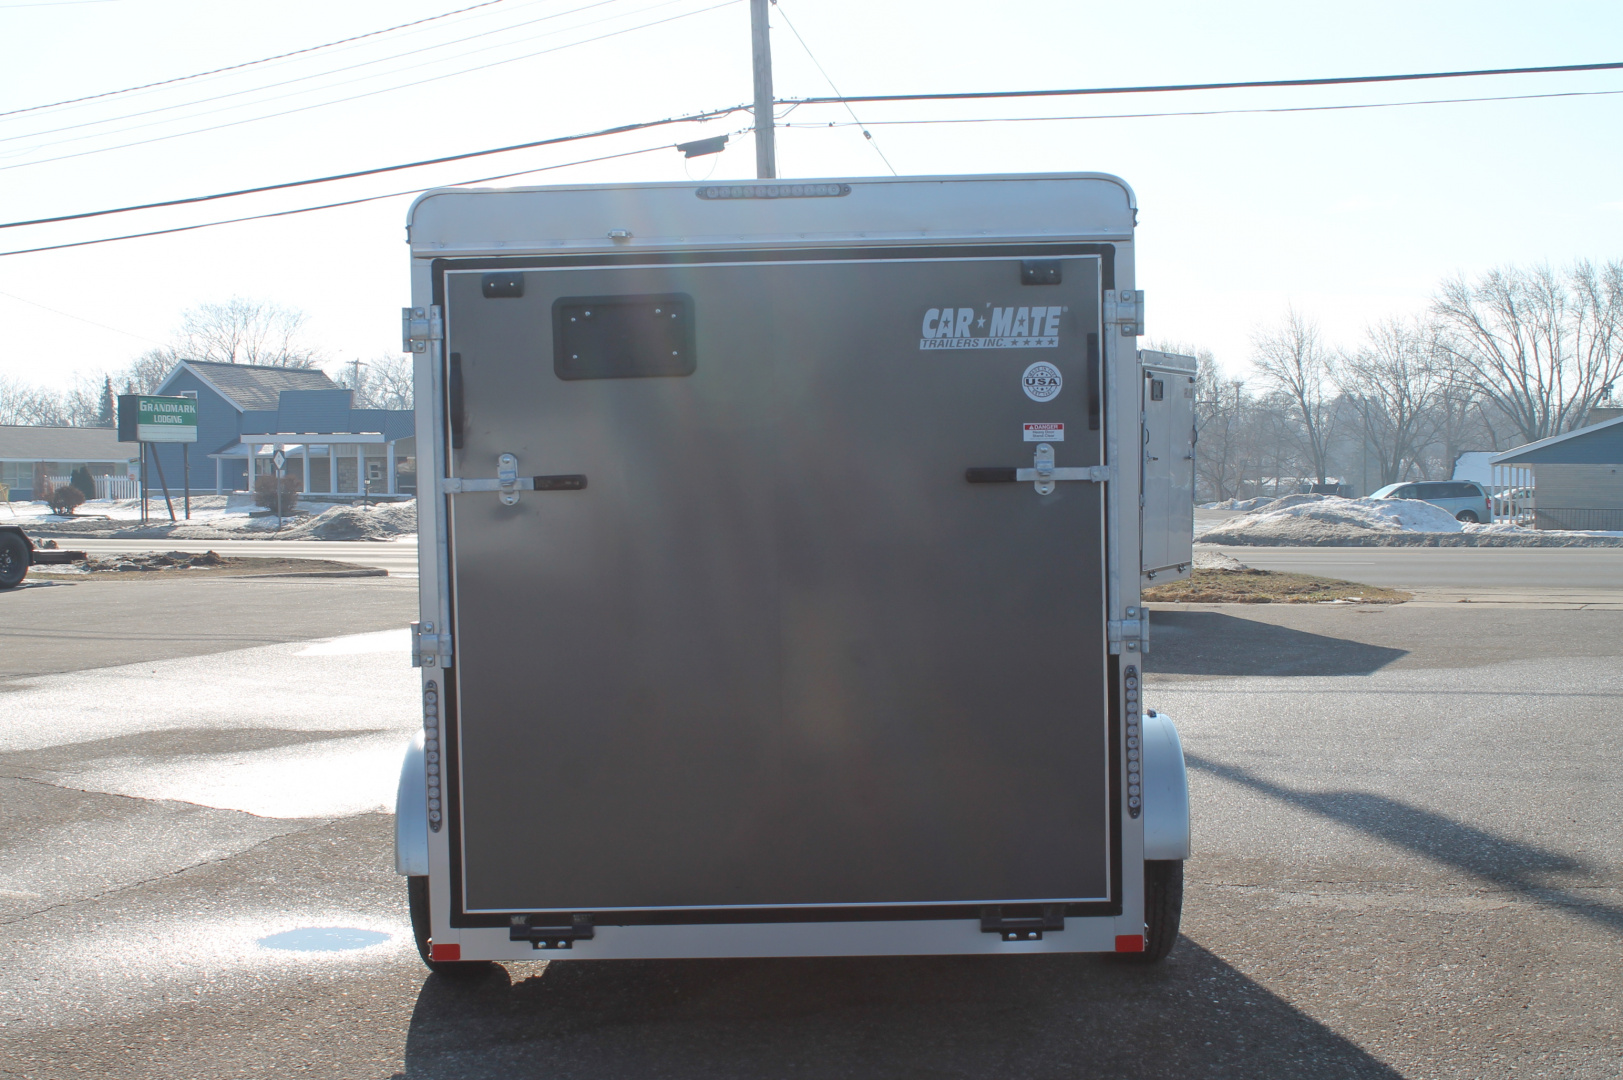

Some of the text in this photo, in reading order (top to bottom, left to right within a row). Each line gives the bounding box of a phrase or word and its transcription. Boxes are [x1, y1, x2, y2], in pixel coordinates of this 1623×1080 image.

[922, 306, 1062, 338] CAR MATE
[922, 338, 1006, 348] TRAILERS INC.
[1025, 378, 1057, 386] USA
[140, 400, 196, 413] GRANDMARK
[153, 414, 183, 424] LODGING
